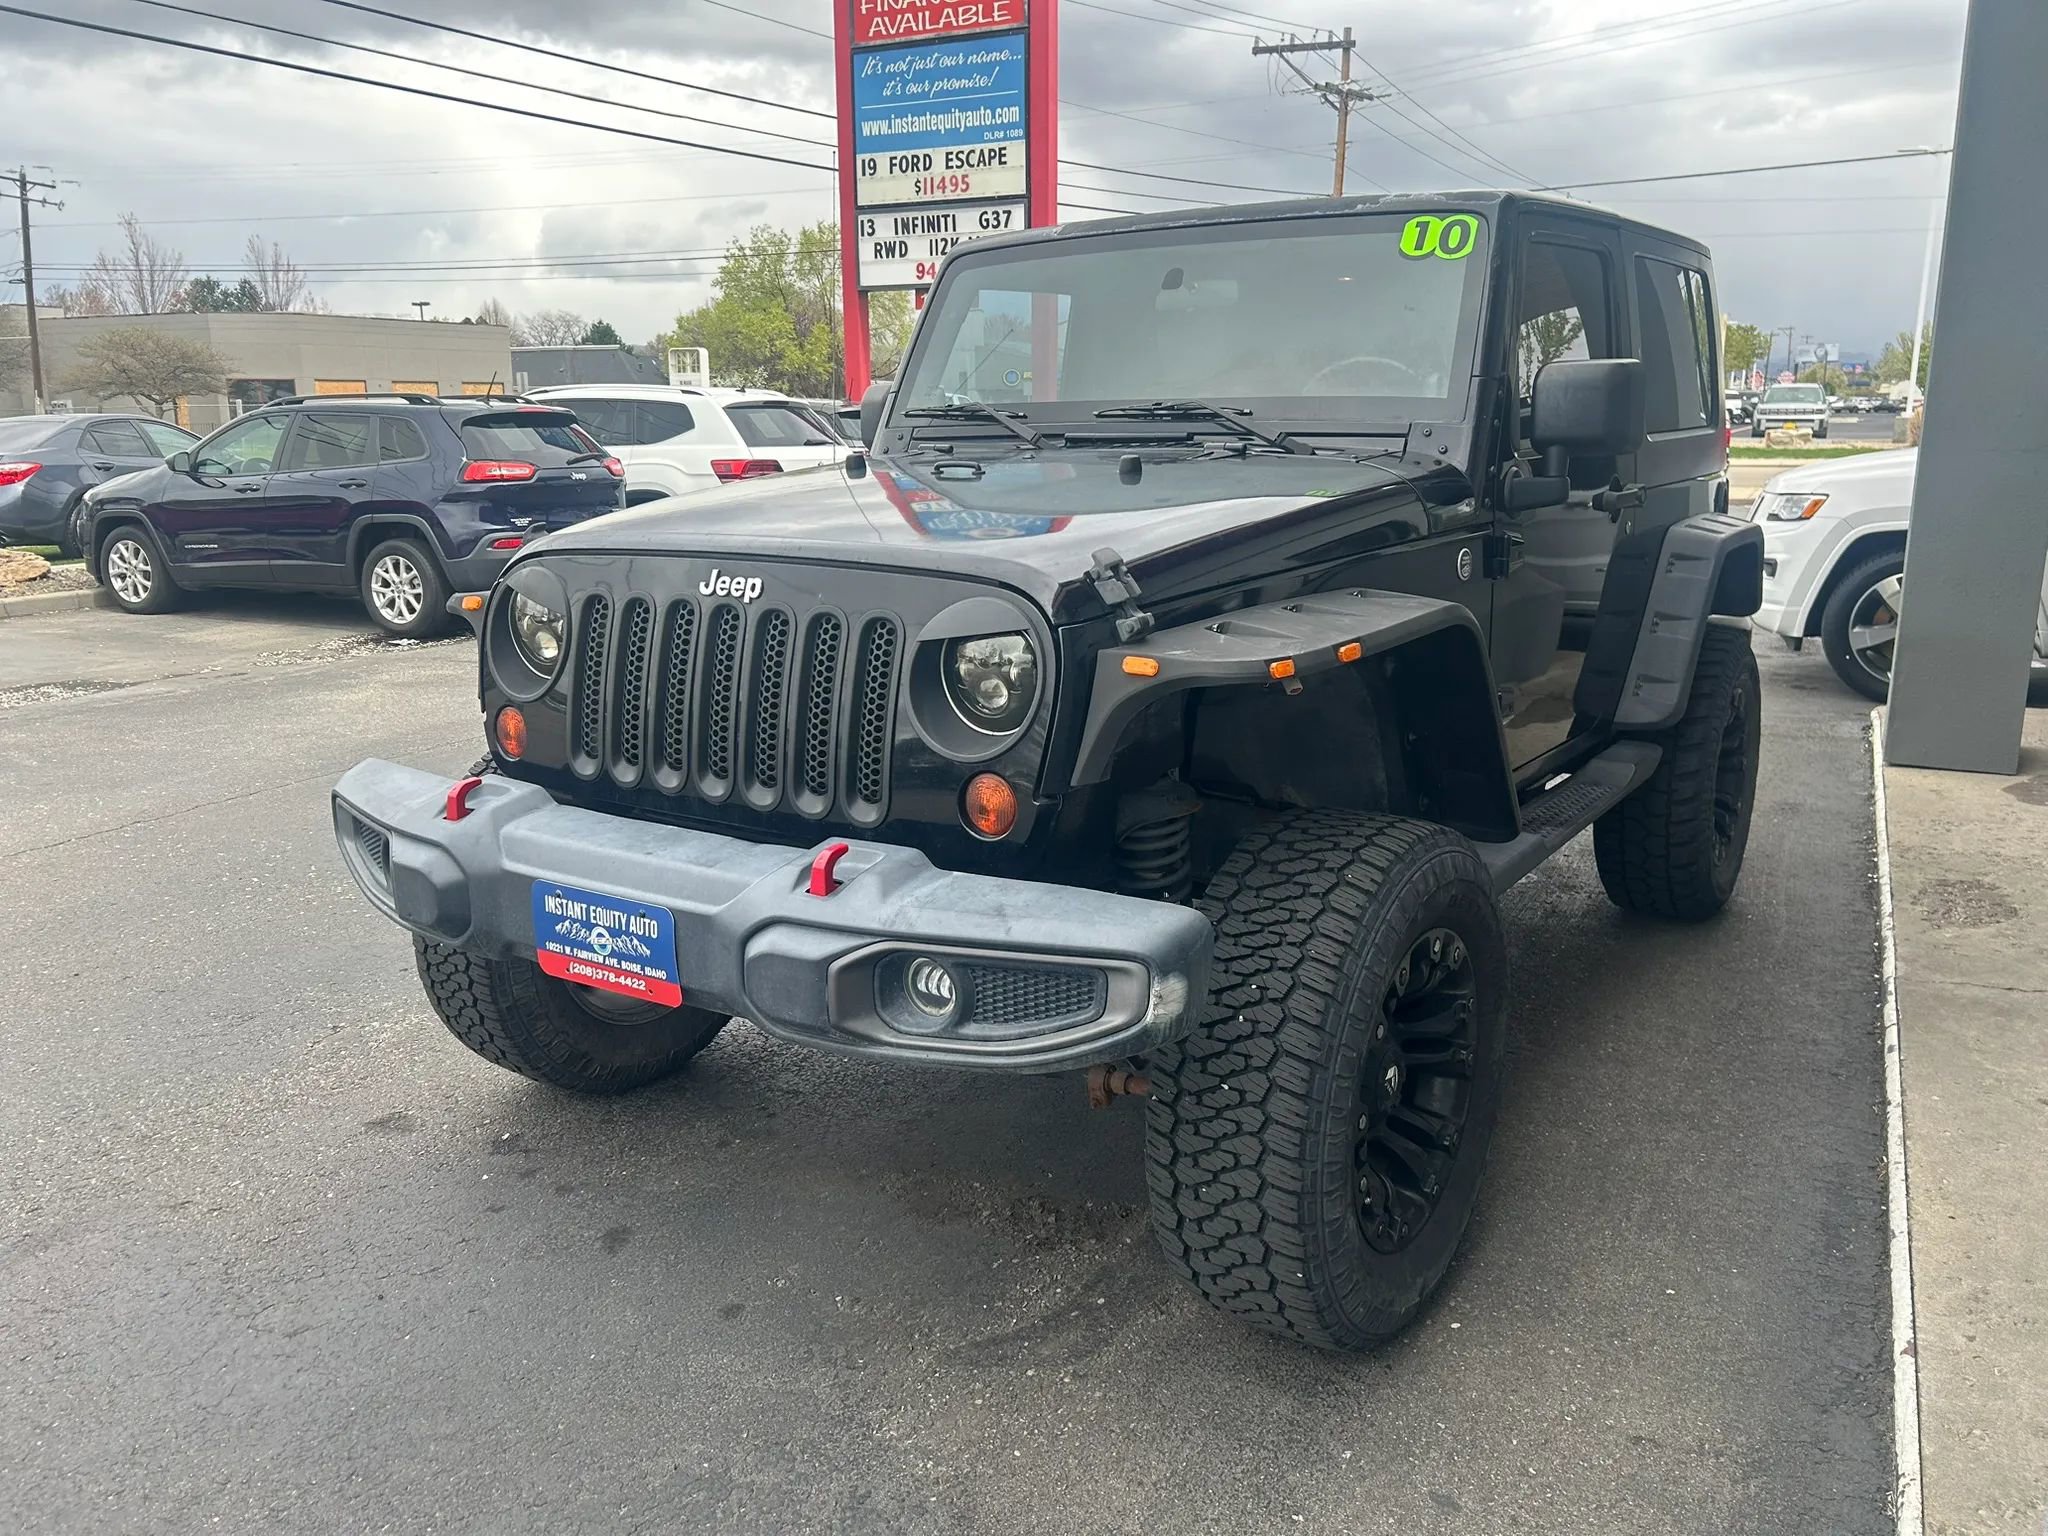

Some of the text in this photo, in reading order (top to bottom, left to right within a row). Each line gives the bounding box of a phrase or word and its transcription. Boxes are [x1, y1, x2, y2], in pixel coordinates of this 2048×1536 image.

[868, 1, 1012, 37] AVAILABLE
[861, 49, 1022, 80] It's not just our name...
[883, 66, 999, 99] it's our promise!
[861, 105, 1020, 137] www.instantequityauto.com
[984, 129, 1023, 141] DLR# 1089
[861, 147, 1007, 177] 19 FORD ESCAPE
[914, 174, 970, 196] $11495
[860, 210, 1012, 237] 13 INFINITI G37
[1409, 217, 1473, 257] 10
[874, 241, 908, 259] RWD
[699, 568, 763, 604] Jeep
[545, 895, 658, 939] INSTANT EQUITY AUTO
[569, 961, 646, 990] (208)378-4422
[573, 948, 604, 964] FAIRVIEW
[645, 966, 667, 980] IDAHO
